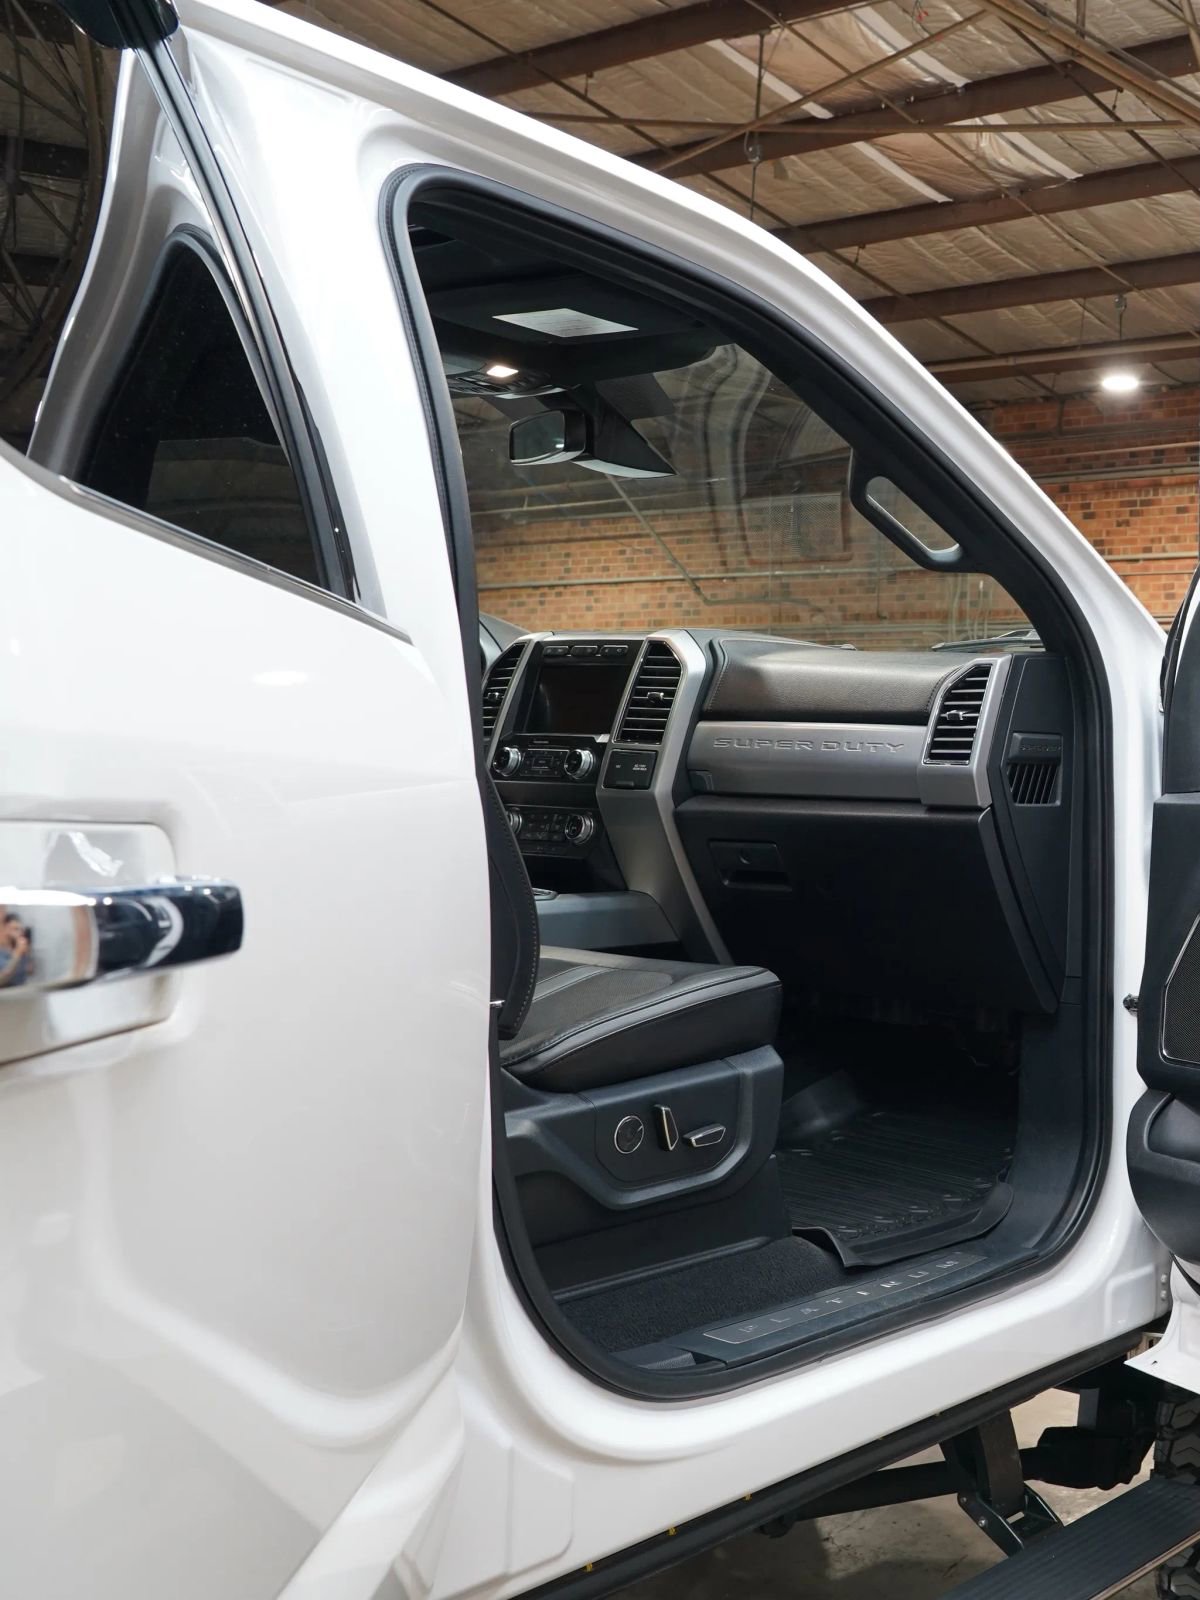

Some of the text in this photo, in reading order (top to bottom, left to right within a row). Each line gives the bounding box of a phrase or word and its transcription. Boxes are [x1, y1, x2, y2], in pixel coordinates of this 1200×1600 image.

[713, 737, 905, 753] SUPER DUTY
[738, 1259, 960, 1333] PLATINUM
